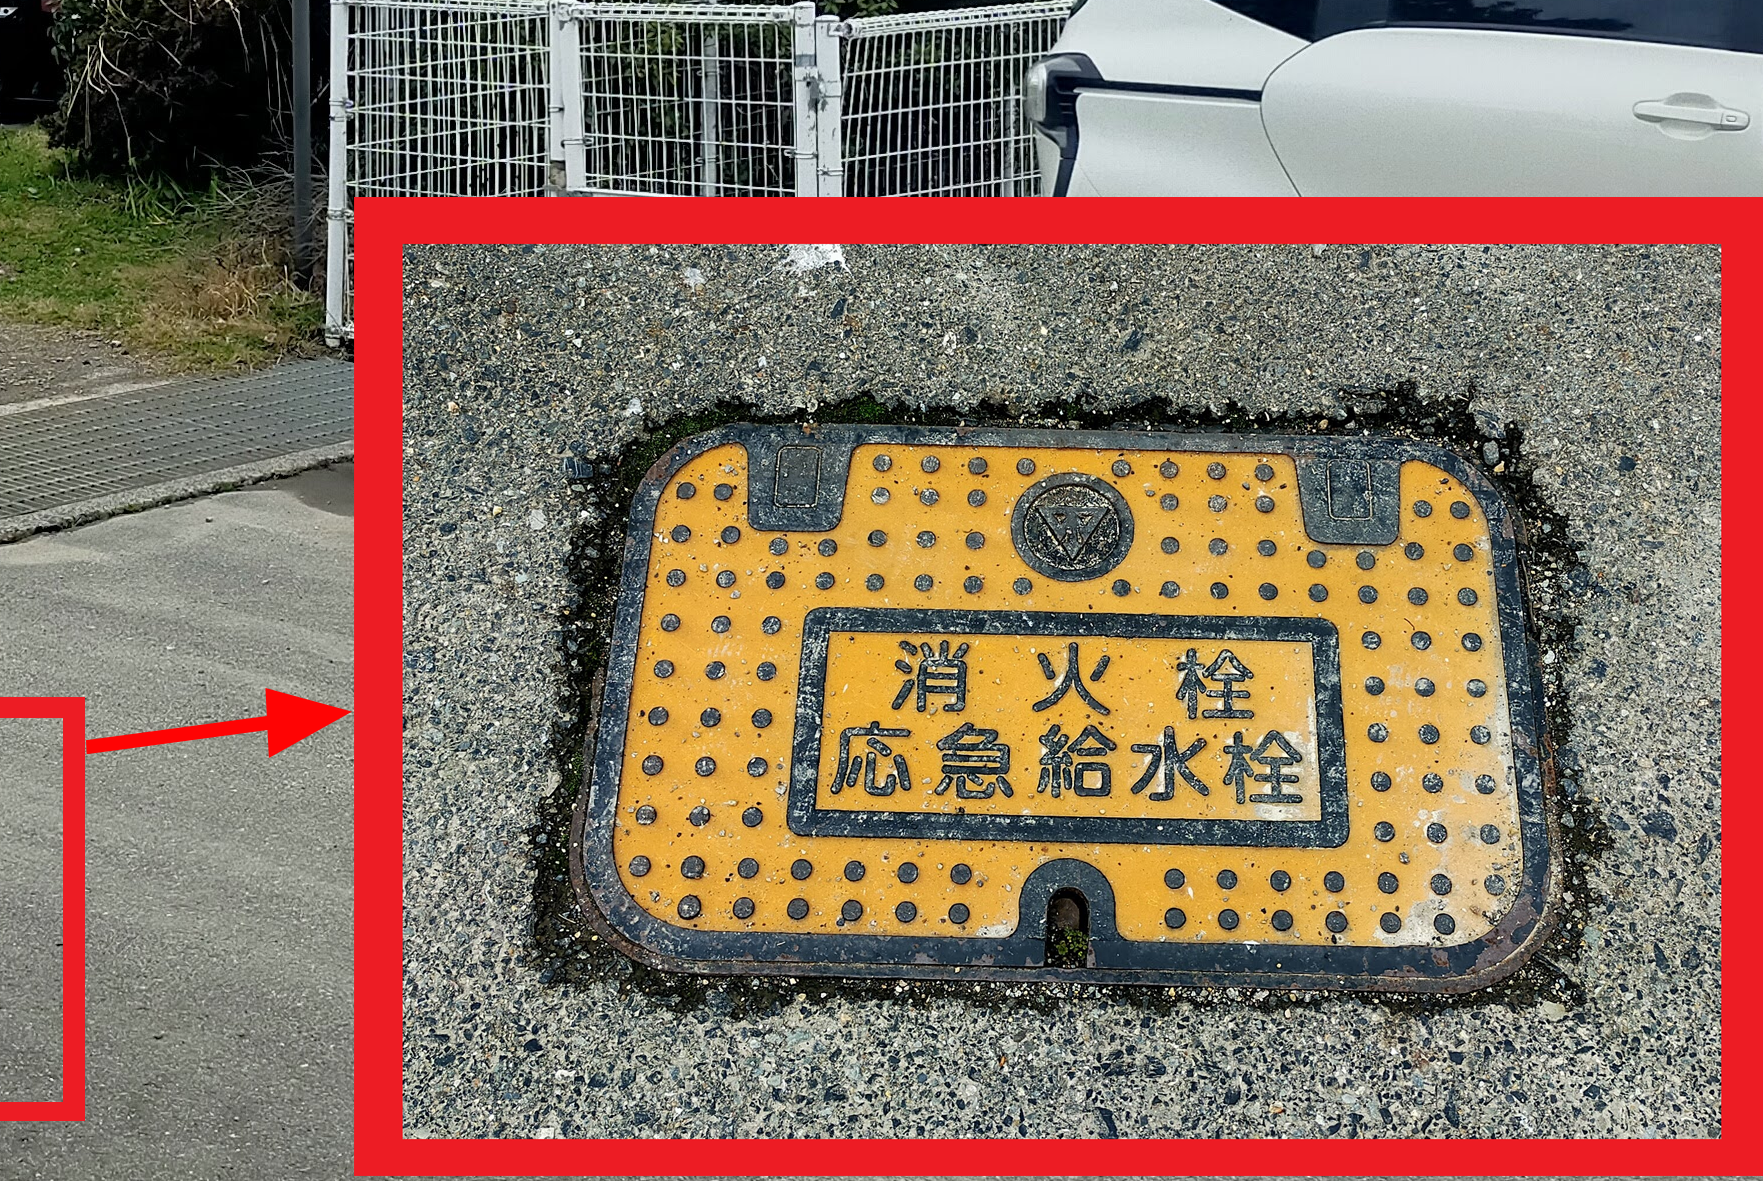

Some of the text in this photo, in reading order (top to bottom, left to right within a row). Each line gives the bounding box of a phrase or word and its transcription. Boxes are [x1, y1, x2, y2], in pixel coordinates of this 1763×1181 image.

[891, 637, 1256, 720] 消火栓
[828, 720, 1305, 806] 応急給水栓
